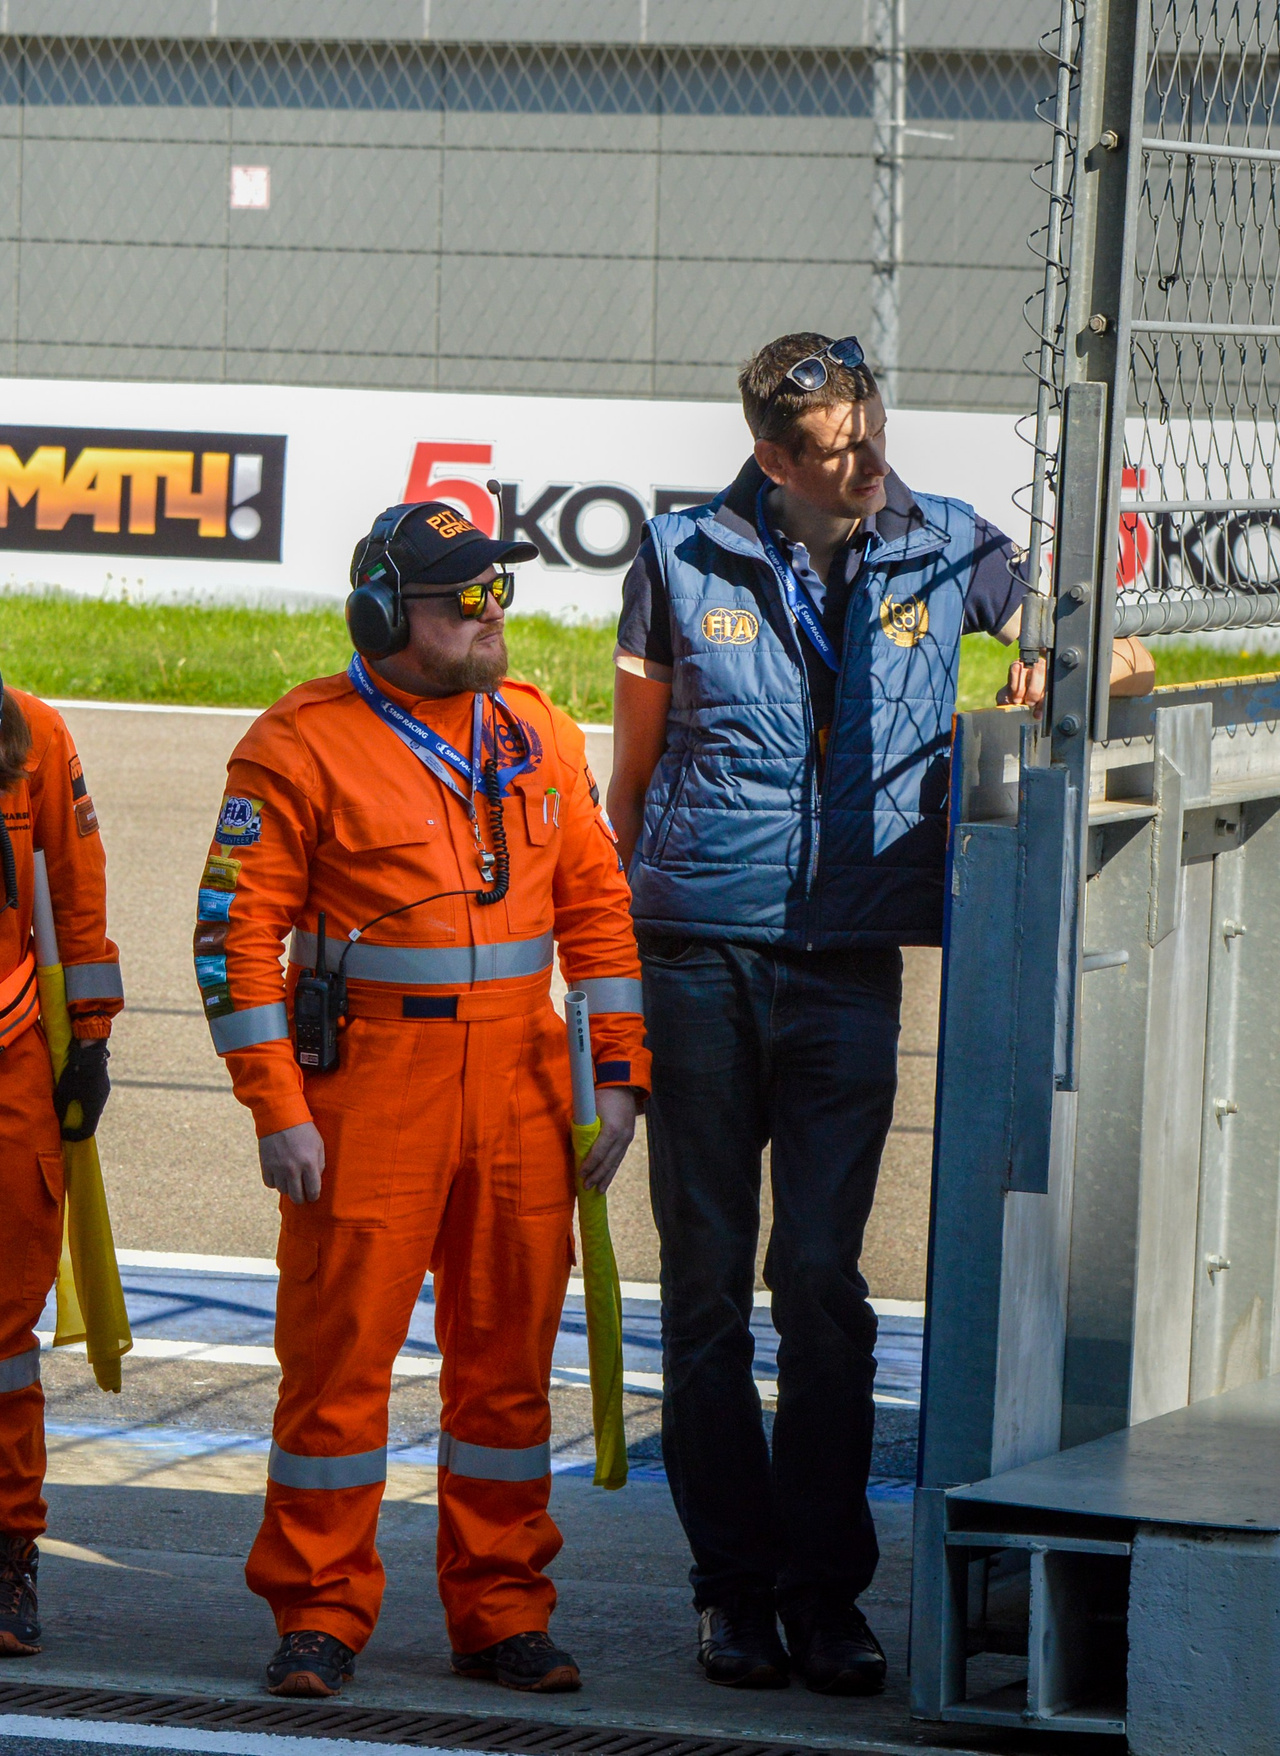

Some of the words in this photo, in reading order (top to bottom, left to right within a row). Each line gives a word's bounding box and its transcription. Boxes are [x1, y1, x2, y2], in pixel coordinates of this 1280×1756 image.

[426, 510, 456, 530] PIT
[768, 550, 780, 567] SMP
[776, 565, 795, 592] RACING
[801, 610, 813, 626] SMP
[810, 624, 829, 652] RACING
[358, 671, 374, 695] RACING
[388, 706, 404, 721] SMP
[402, 717, 429, 739] RACING
[444, 749, 461, 763] SMP
